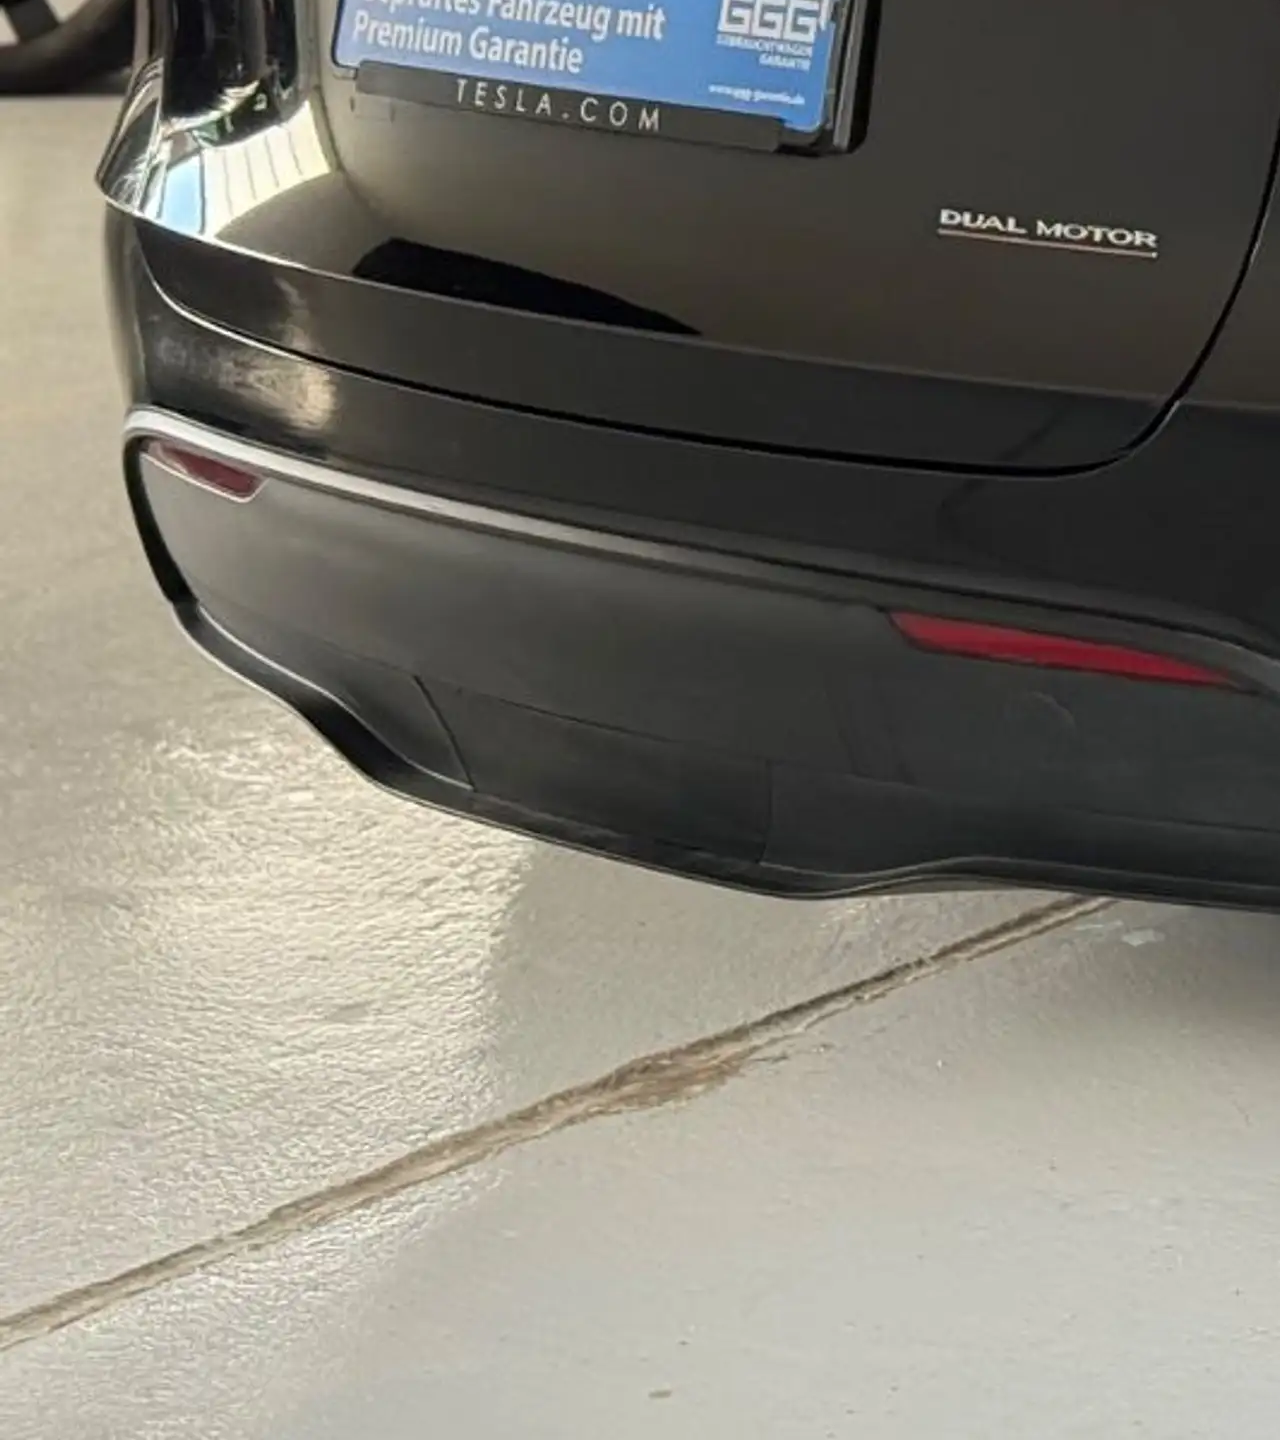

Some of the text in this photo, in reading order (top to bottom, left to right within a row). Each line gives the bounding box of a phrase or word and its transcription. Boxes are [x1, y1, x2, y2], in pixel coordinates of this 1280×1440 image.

[352, 16, 584, 74] Premium Garantie
[616, 4, 666, 41] mit
[455, 78, 662, 132] TESLA.COM
[939, 208, 1158, 248] DUAL MOTOR
